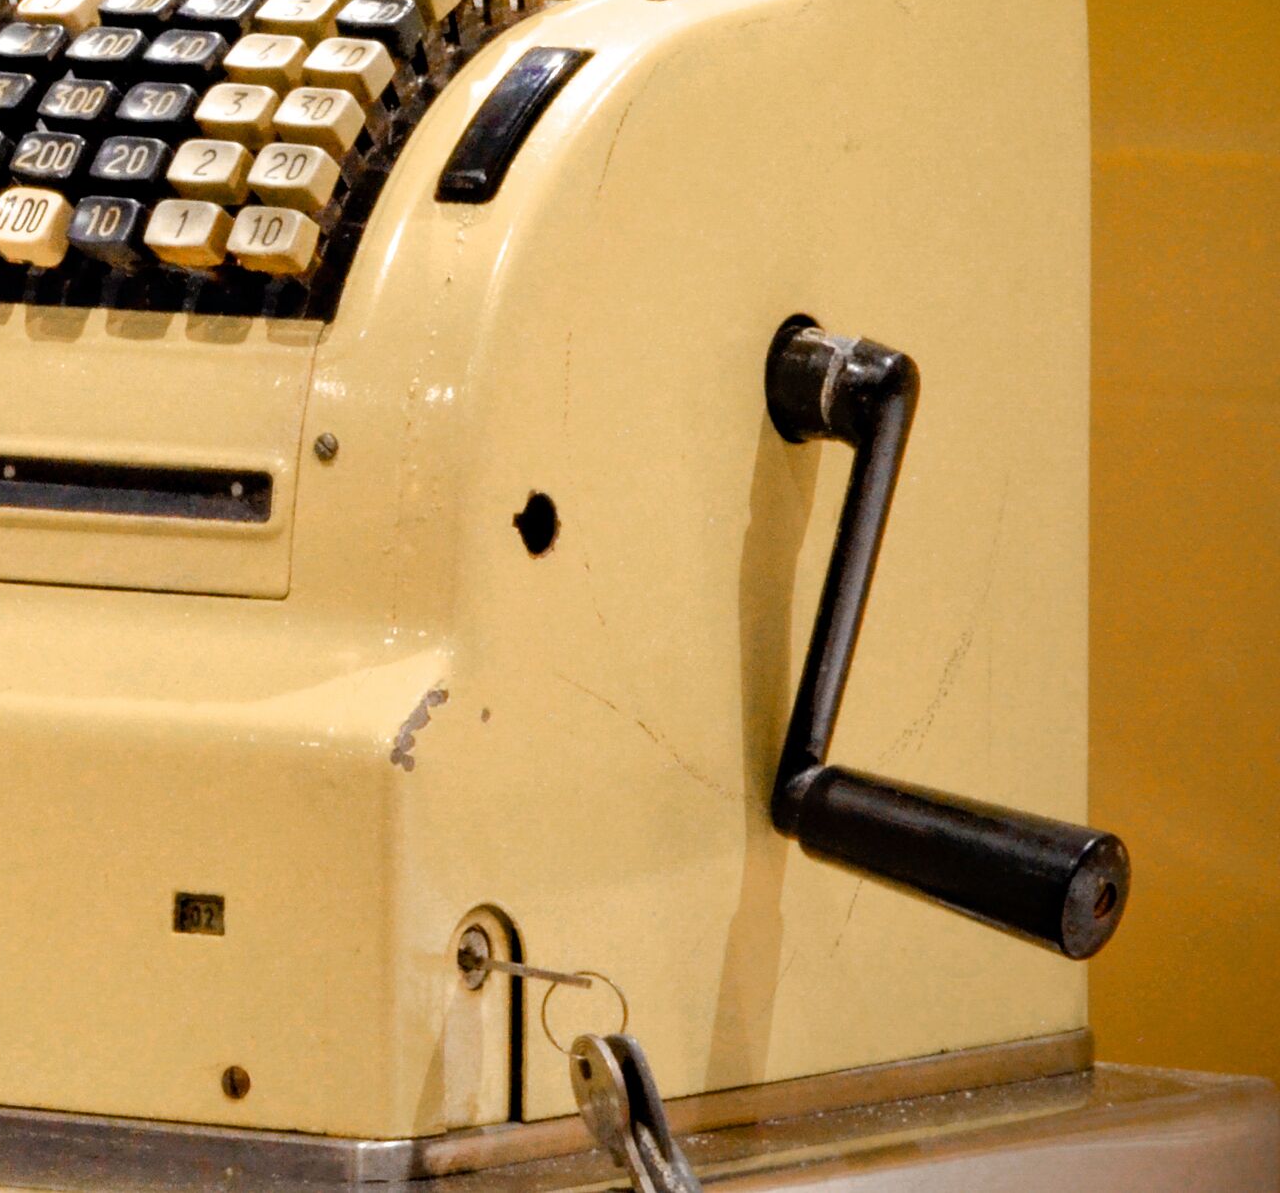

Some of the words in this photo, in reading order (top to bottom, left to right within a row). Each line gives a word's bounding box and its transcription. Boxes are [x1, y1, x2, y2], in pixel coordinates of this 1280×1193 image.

[51, 84, 105, 114] 300
[139, 89, 177, 116] 30
[227, 92, 249, 116] 3
[298, 94, 335, 121] 30
[14, 141, 75, 171] 200
[103, 144, 149, 174] 20
[192, 149, 218, 177] 2
[263, 152, 308, 182] 20
[86, 204, 121, 237] 10
[173, 209, 190, 239] 1
[247, 215, 284, 247] 10
